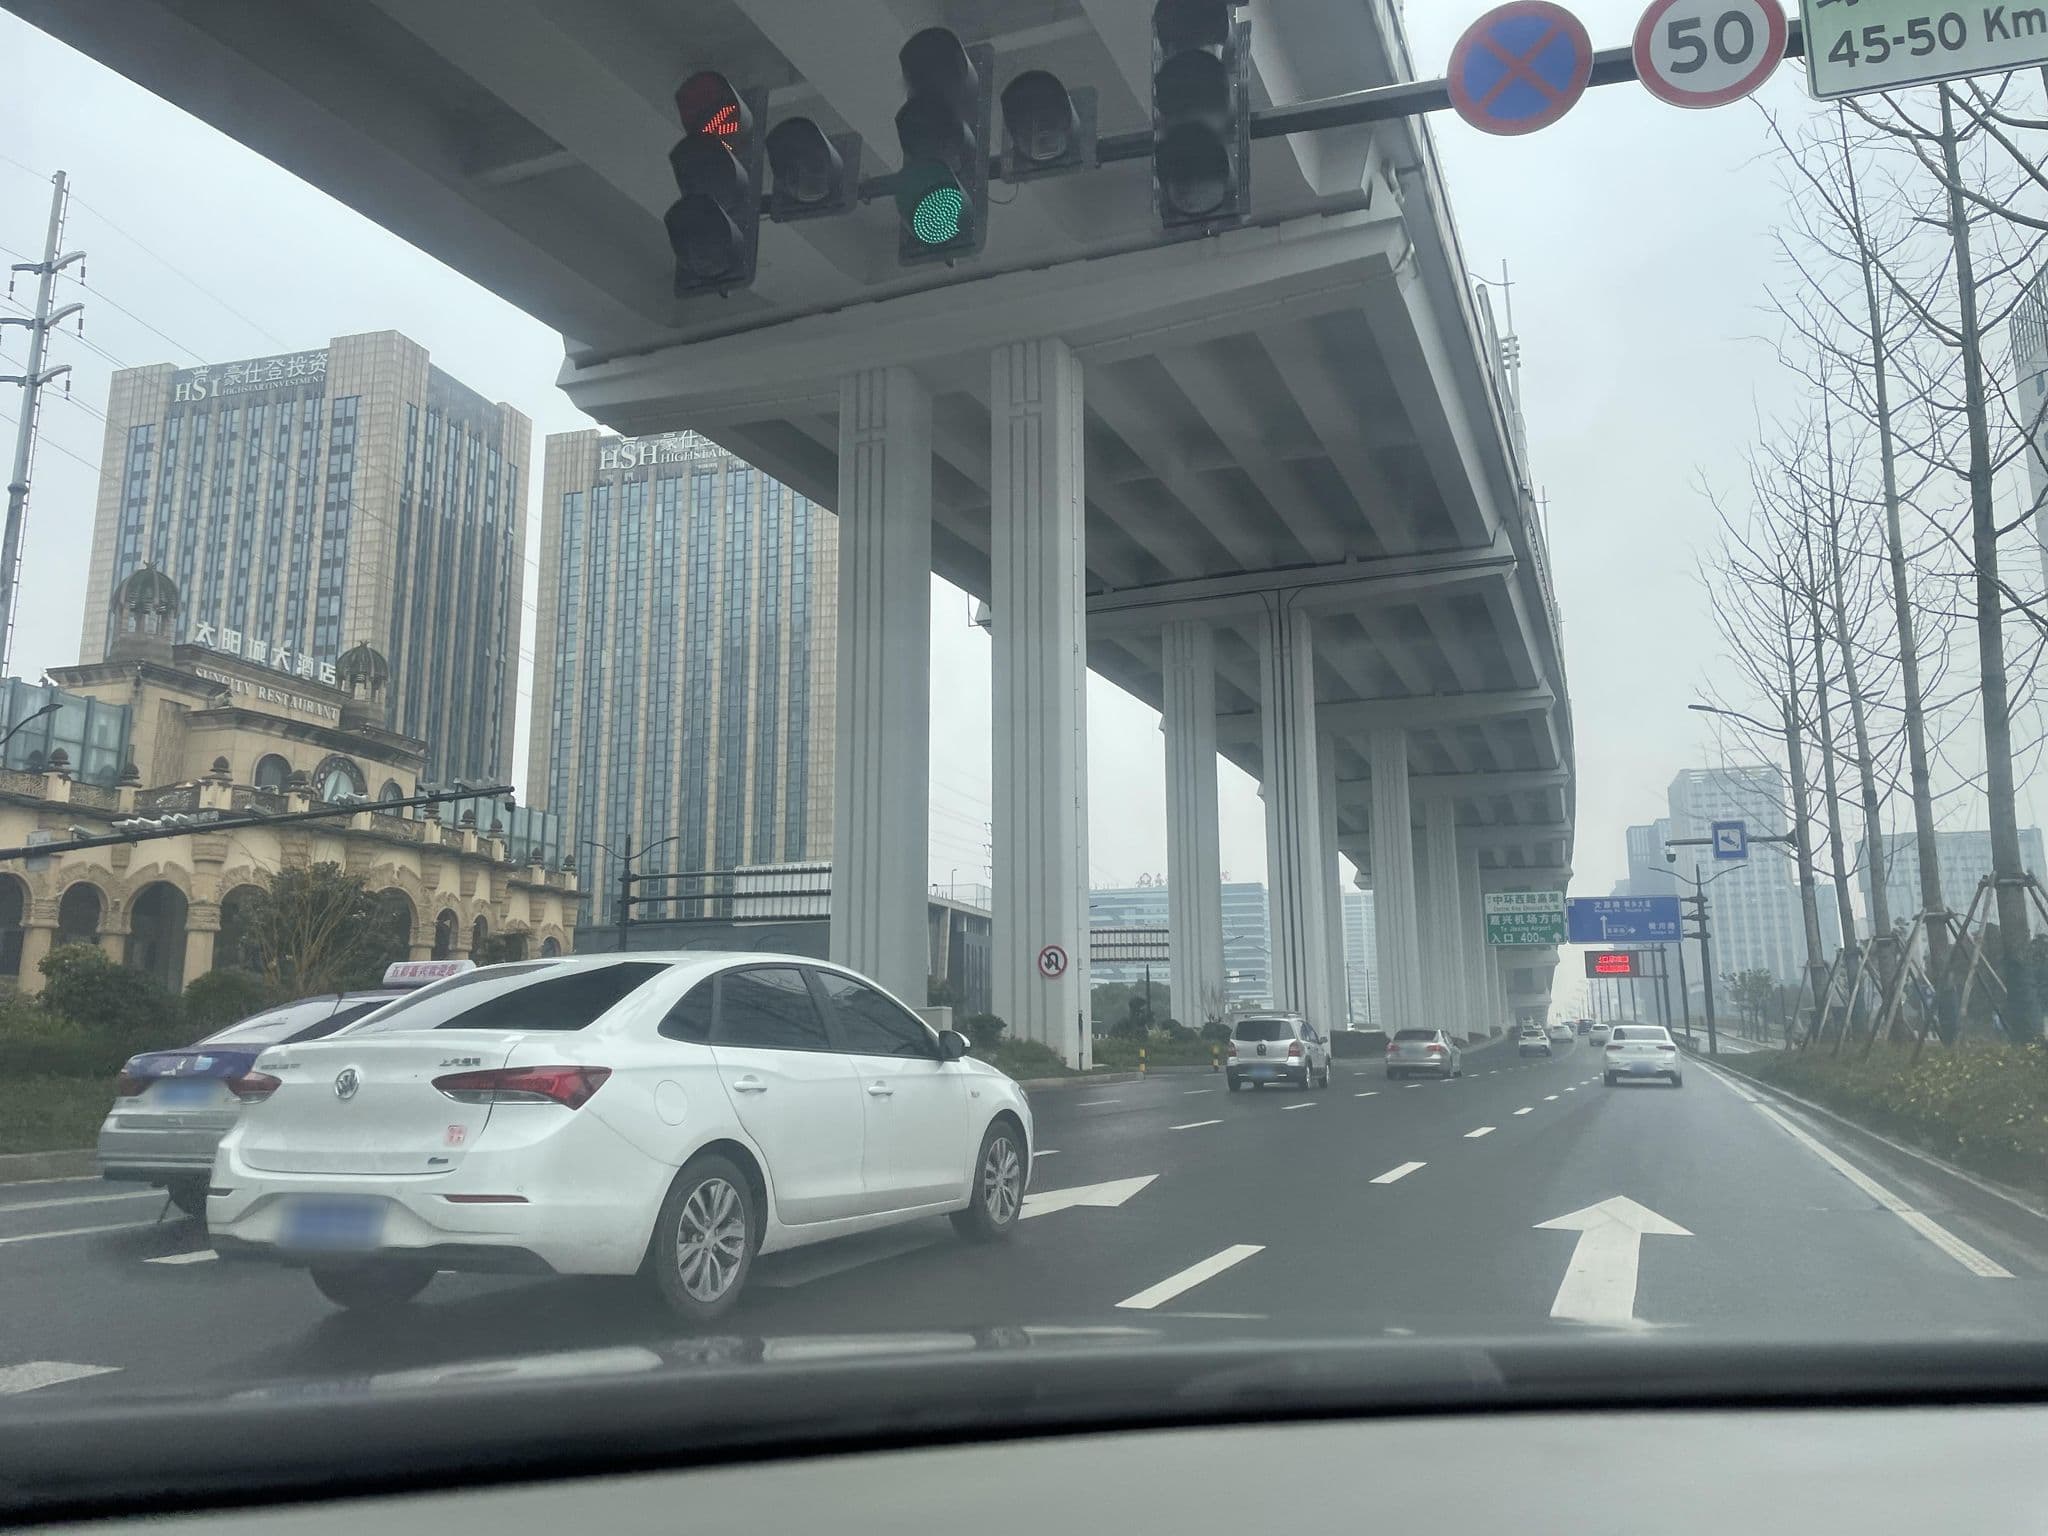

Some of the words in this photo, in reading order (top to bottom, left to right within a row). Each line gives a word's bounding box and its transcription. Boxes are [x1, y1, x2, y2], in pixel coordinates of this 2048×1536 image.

[1667, 10, 1754, 74] 50
[1828, 12, 1967, 67] 45-50
[223, 352, 328, 386] 豪仕登投资
[600, 441, 658, 470] HSH
[195, 621, 336, 685] 太阳城大酒店
[258, 687, 337, 720] RESTAURANT
[1490, 913, 1562, 926] 嘉兴机场方向
[1491, 932, 1514, 943] 入口
